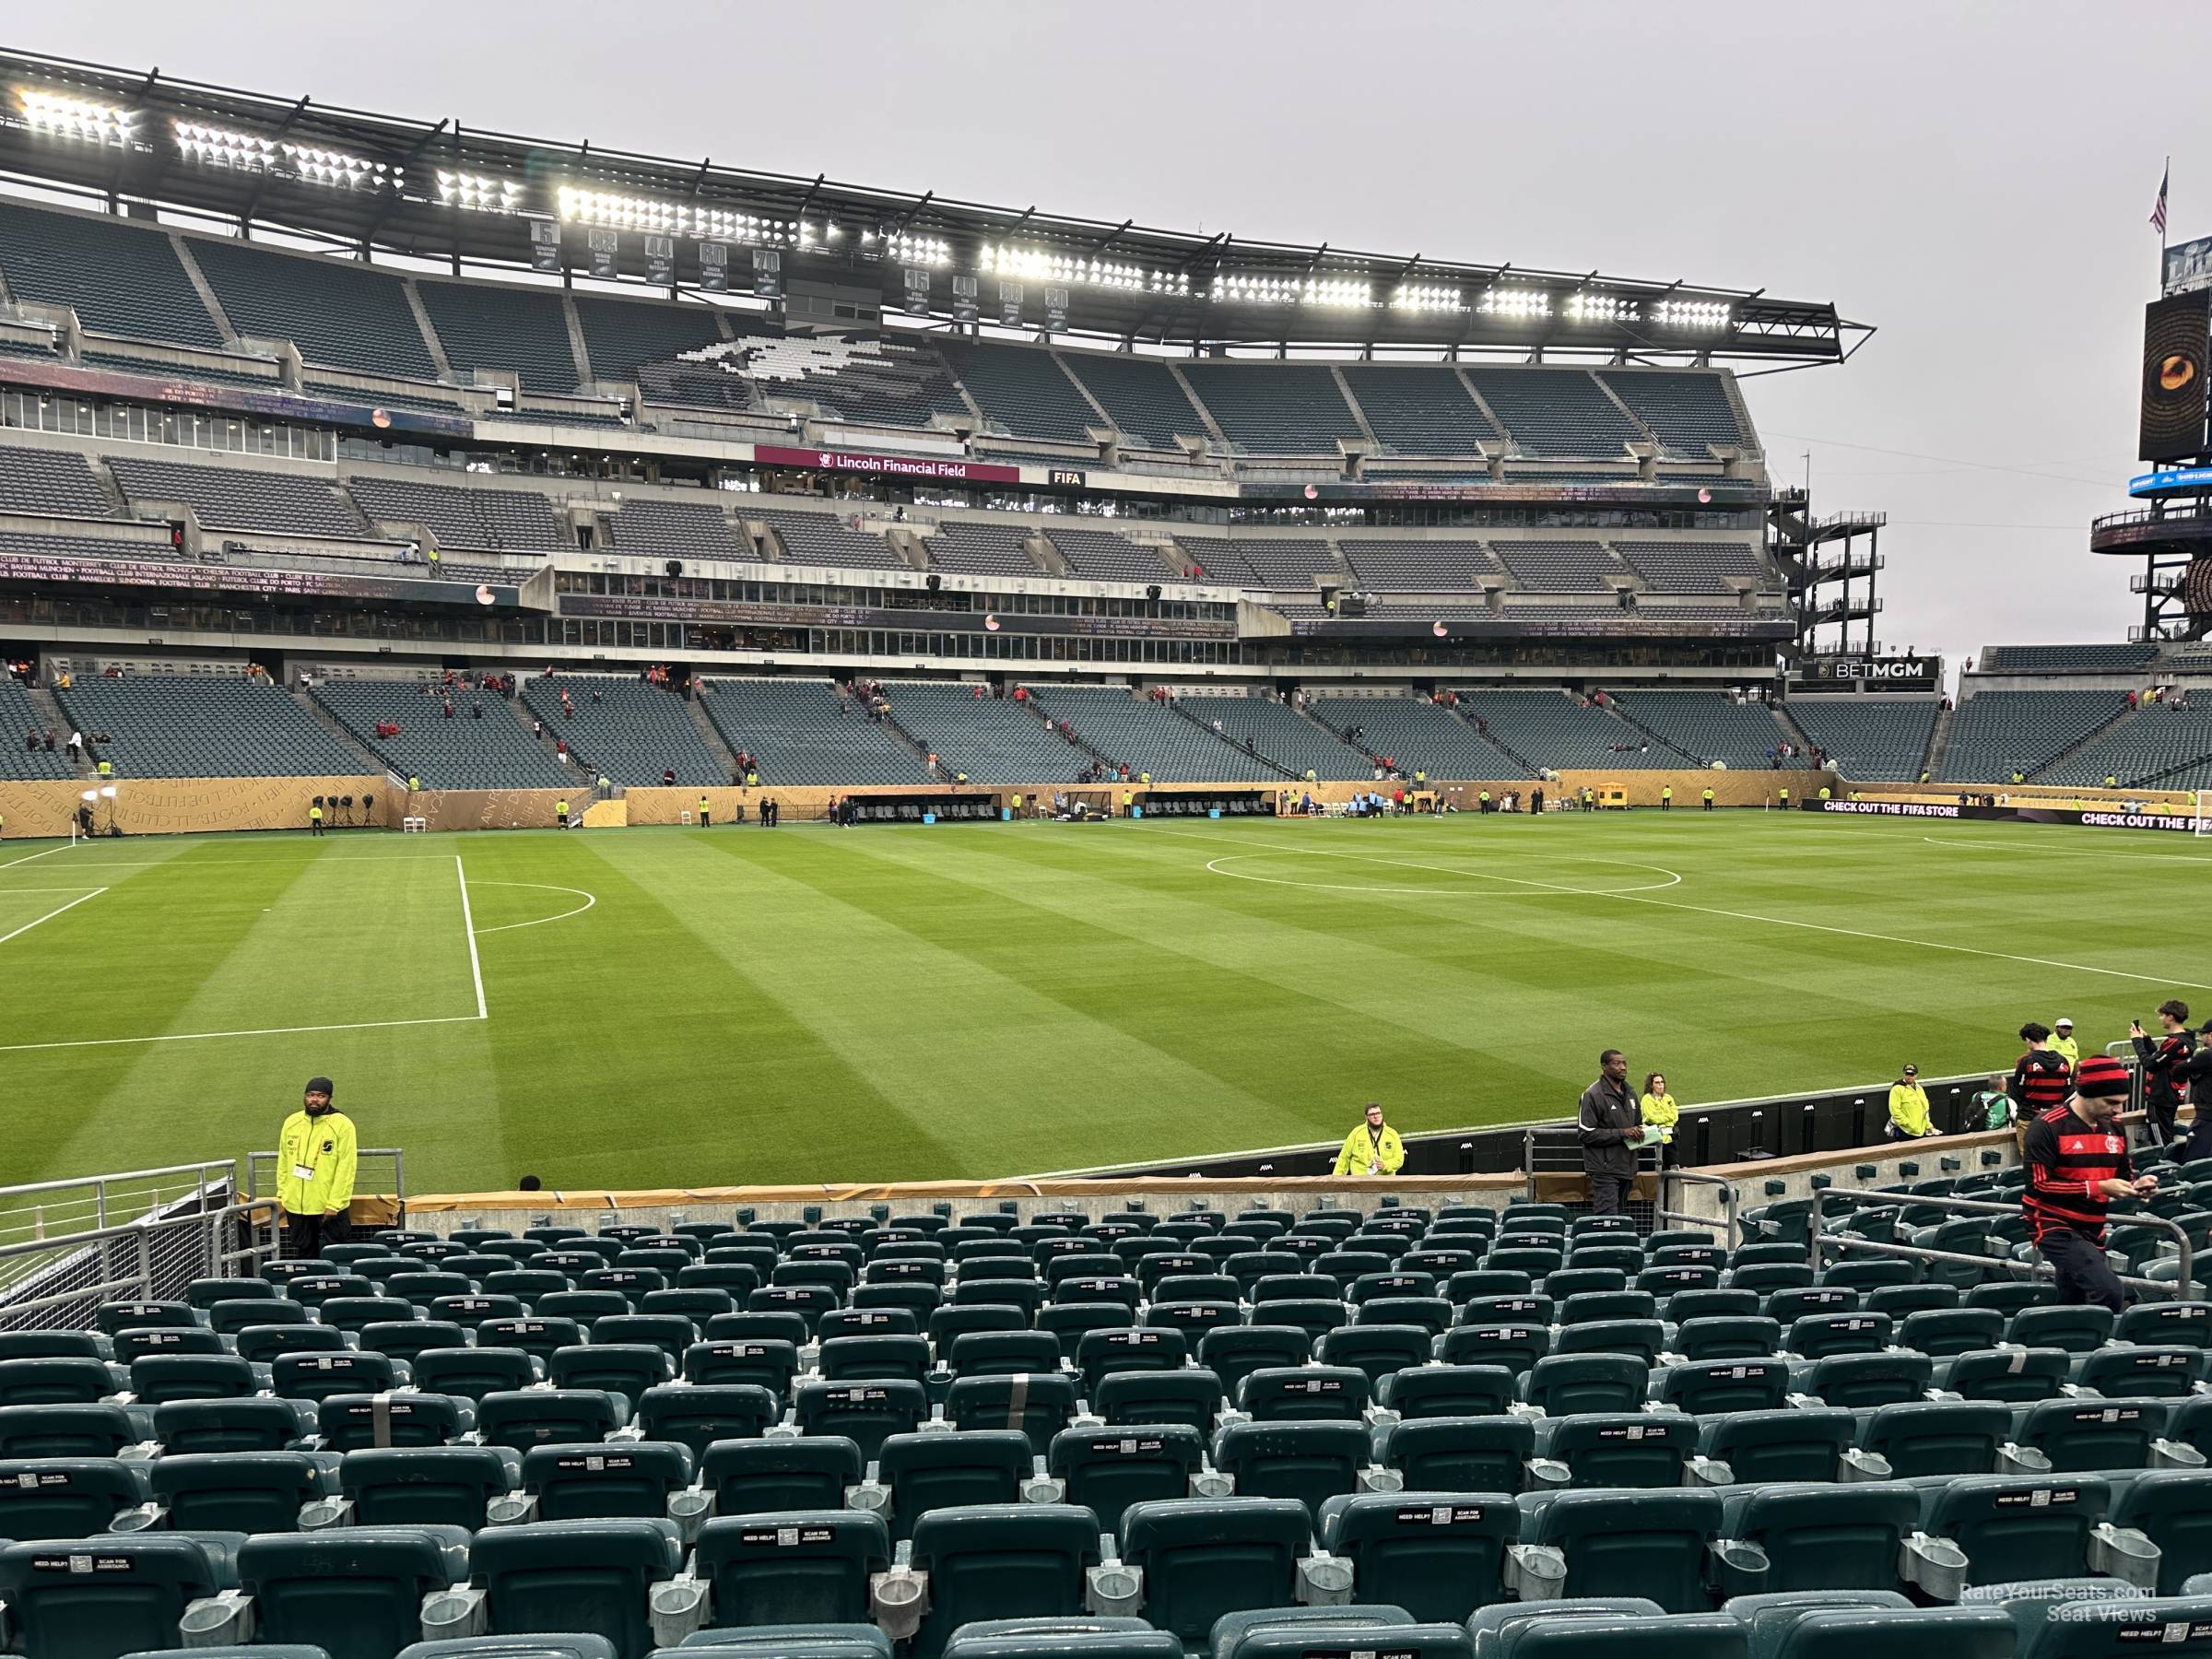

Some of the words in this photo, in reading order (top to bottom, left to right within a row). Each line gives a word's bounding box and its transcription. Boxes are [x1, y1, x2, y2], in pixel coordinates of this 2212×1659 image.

[539, 224, 553, 245] 5
[590, 230, 616, 253] 92
[647, 237, 670, 260] 44
[701, 244, 724, 266] 60
[755, 252, 778, 273] 70
[837, 456, 880, 470] Lincoln
[883, 460, 935, 476] Financial
[938, 465, 966, 477] Field
[1054, 473, 1080, 485] FIFA
[62, 559, 101, 568] MONTERREY
[135, 571, 190, 580] INTERNAZIONALE
[159, 579, 190, 587] FOOTBALL
[1836, 664, 1923, 677] BETMGM
[1824, 801, 1858, 811] CHECK
[1858, 803, 1879, 813] OUT
[1880, 804, 1900, 814] THE
[1902, 805, 1925, 816] FIFA
[1925, 806, 1959, 817] STORE
[2081, 813, 2124, 826] CHECK
[2126, 816, 2156, 828] OUT
[2157, 817, 2185, 830] THE
